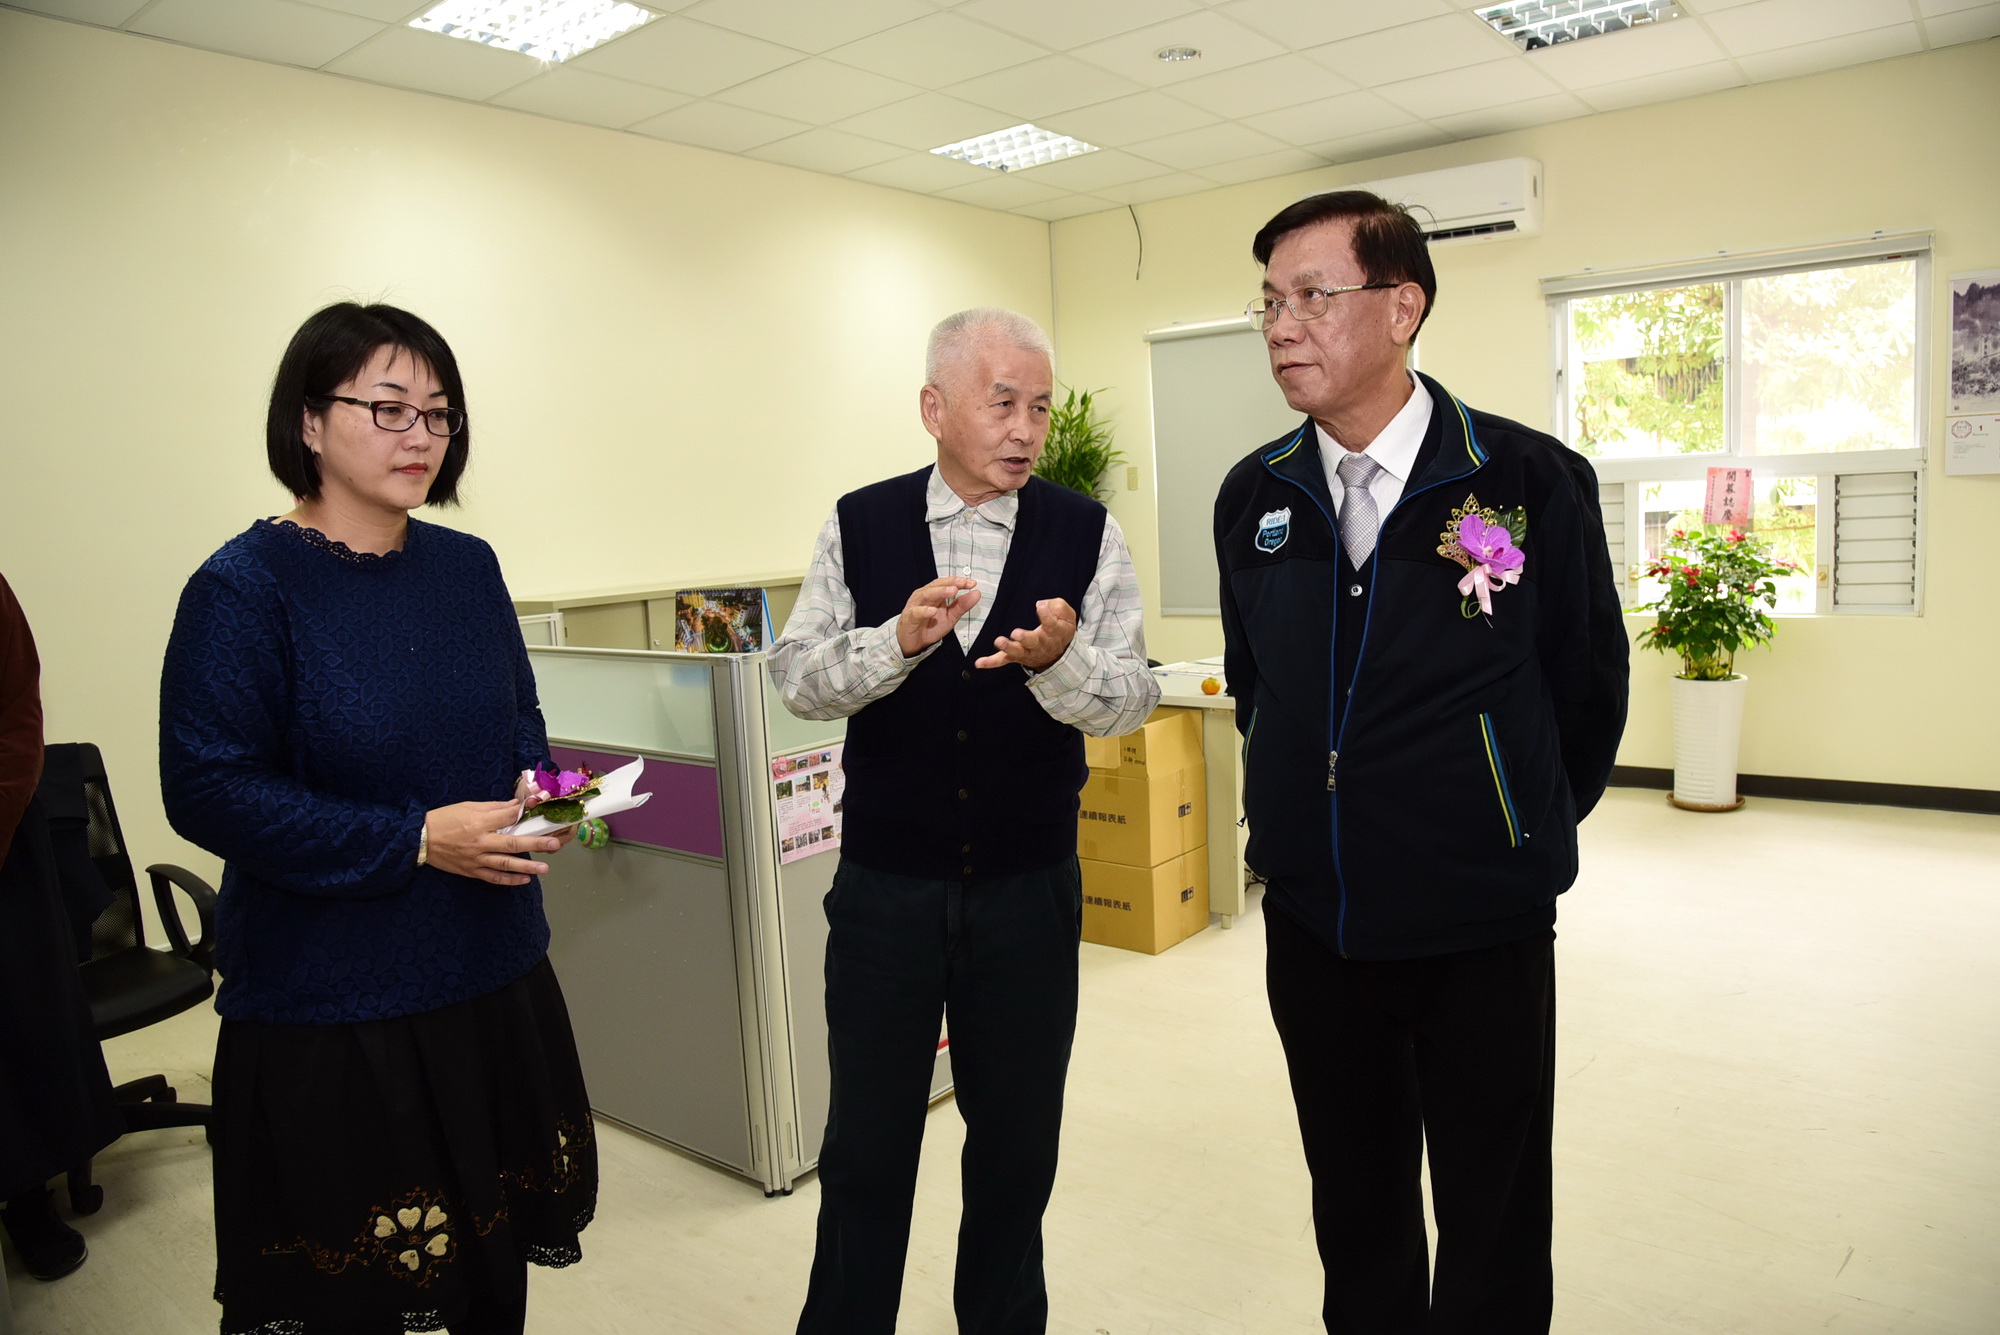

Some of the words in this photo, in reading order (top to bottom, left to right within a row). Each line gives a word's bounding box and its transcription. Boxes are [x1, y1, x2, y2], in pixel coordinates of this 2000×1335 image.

[1082, 894, 1132, 912] 連續報表紙
